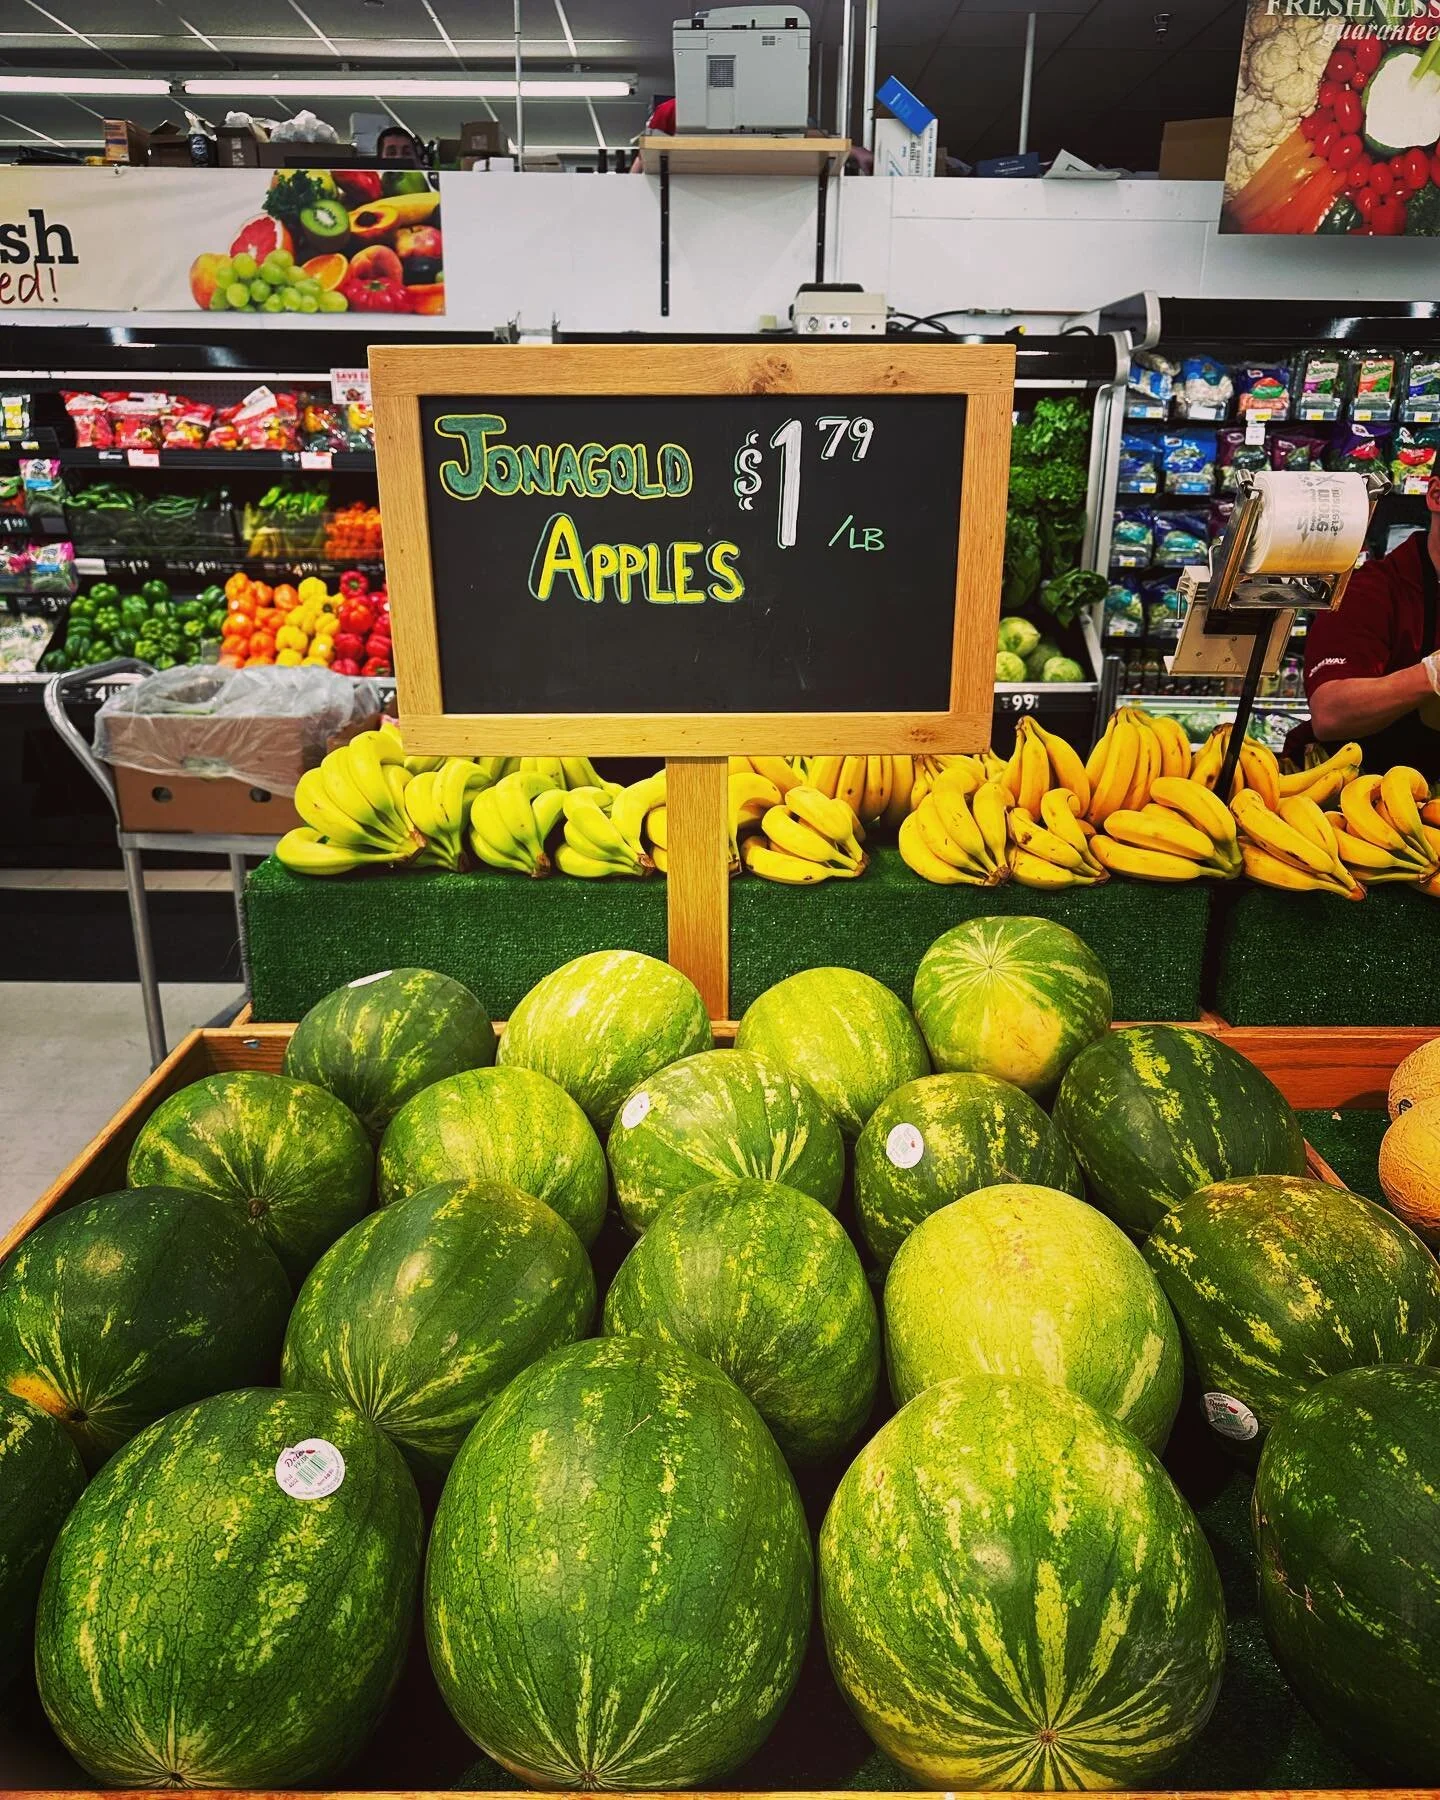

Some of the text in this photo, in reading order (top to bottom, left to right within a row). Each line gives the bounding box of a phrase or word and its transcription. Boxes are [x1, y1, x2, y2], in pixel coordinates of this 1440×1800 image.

[1264, 0, 1440, 18] FRESHNESS
[435, 414, 692, 500] JONAGOLD
[528, 513, 744, 604] APPLES
[828, 515, 885, 551] /LB
